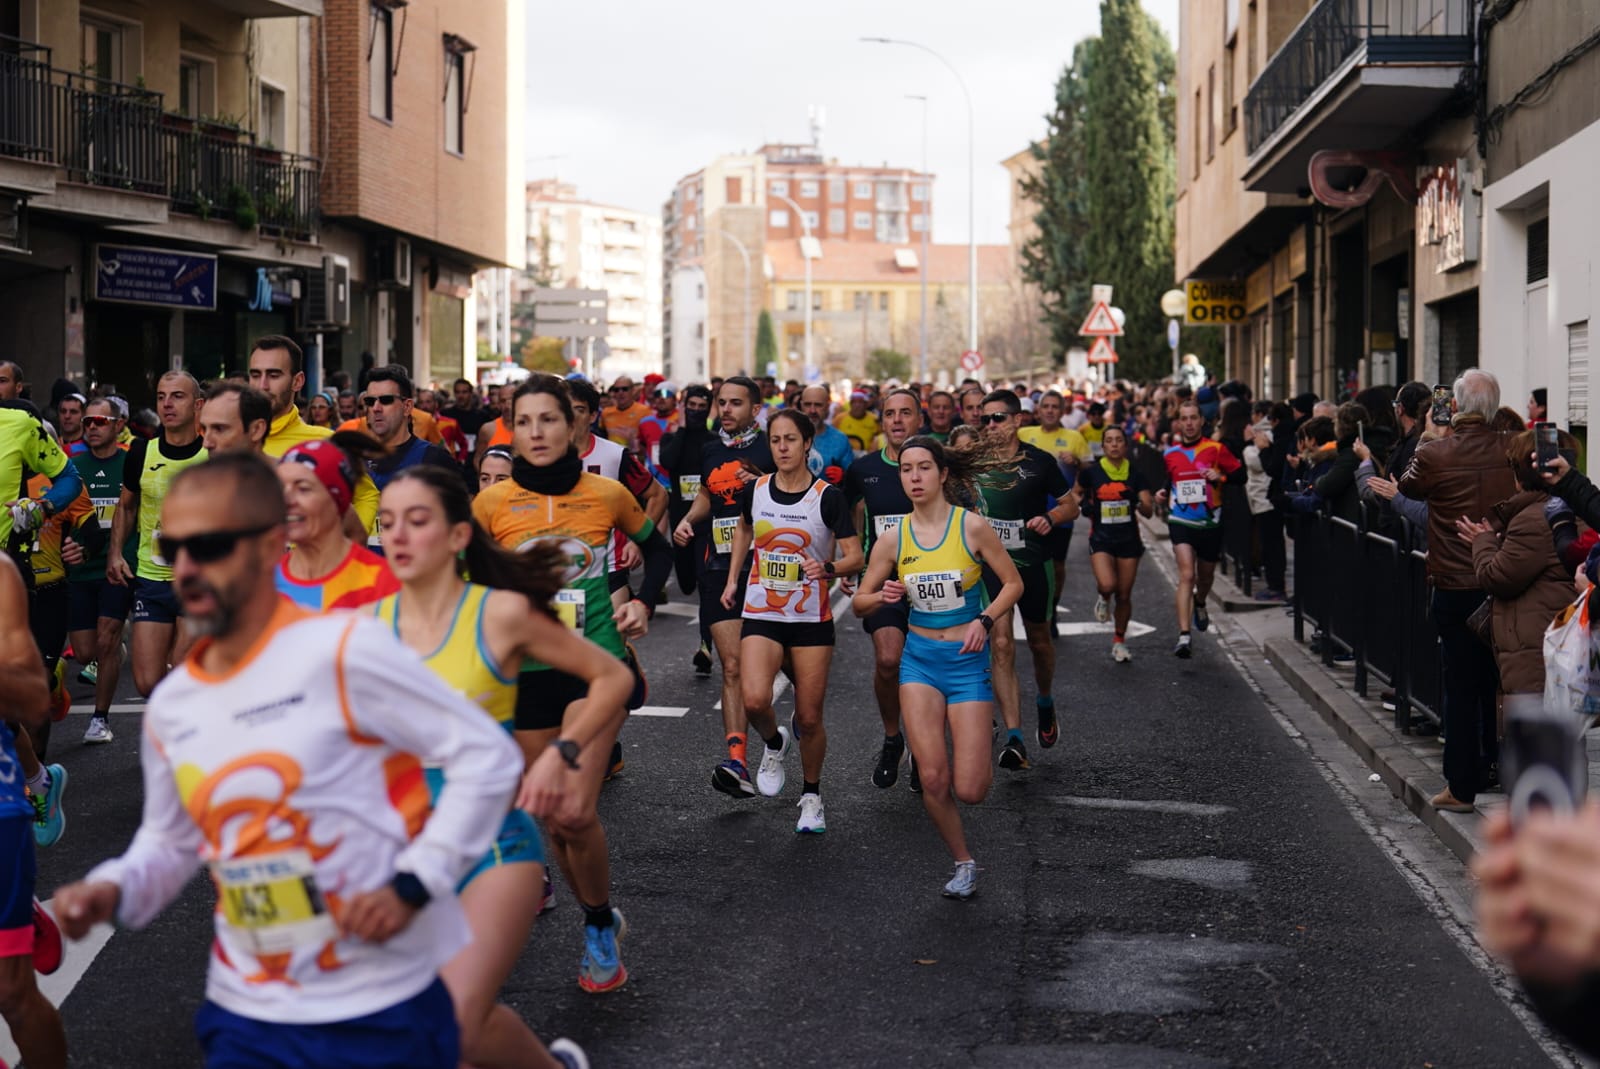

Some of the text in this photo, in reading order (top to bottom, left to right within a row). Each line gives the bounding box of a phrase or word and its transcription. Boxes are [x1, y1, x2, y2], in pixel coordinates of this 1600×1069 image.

[1191, 284, 1247, 302] COMPRO
[1191, 305, 1246, 321] ORO
[767, 562, 786, 578] 109
[919, 573, 956, 582] SETEL
[917, 582, 946, 600] 840
